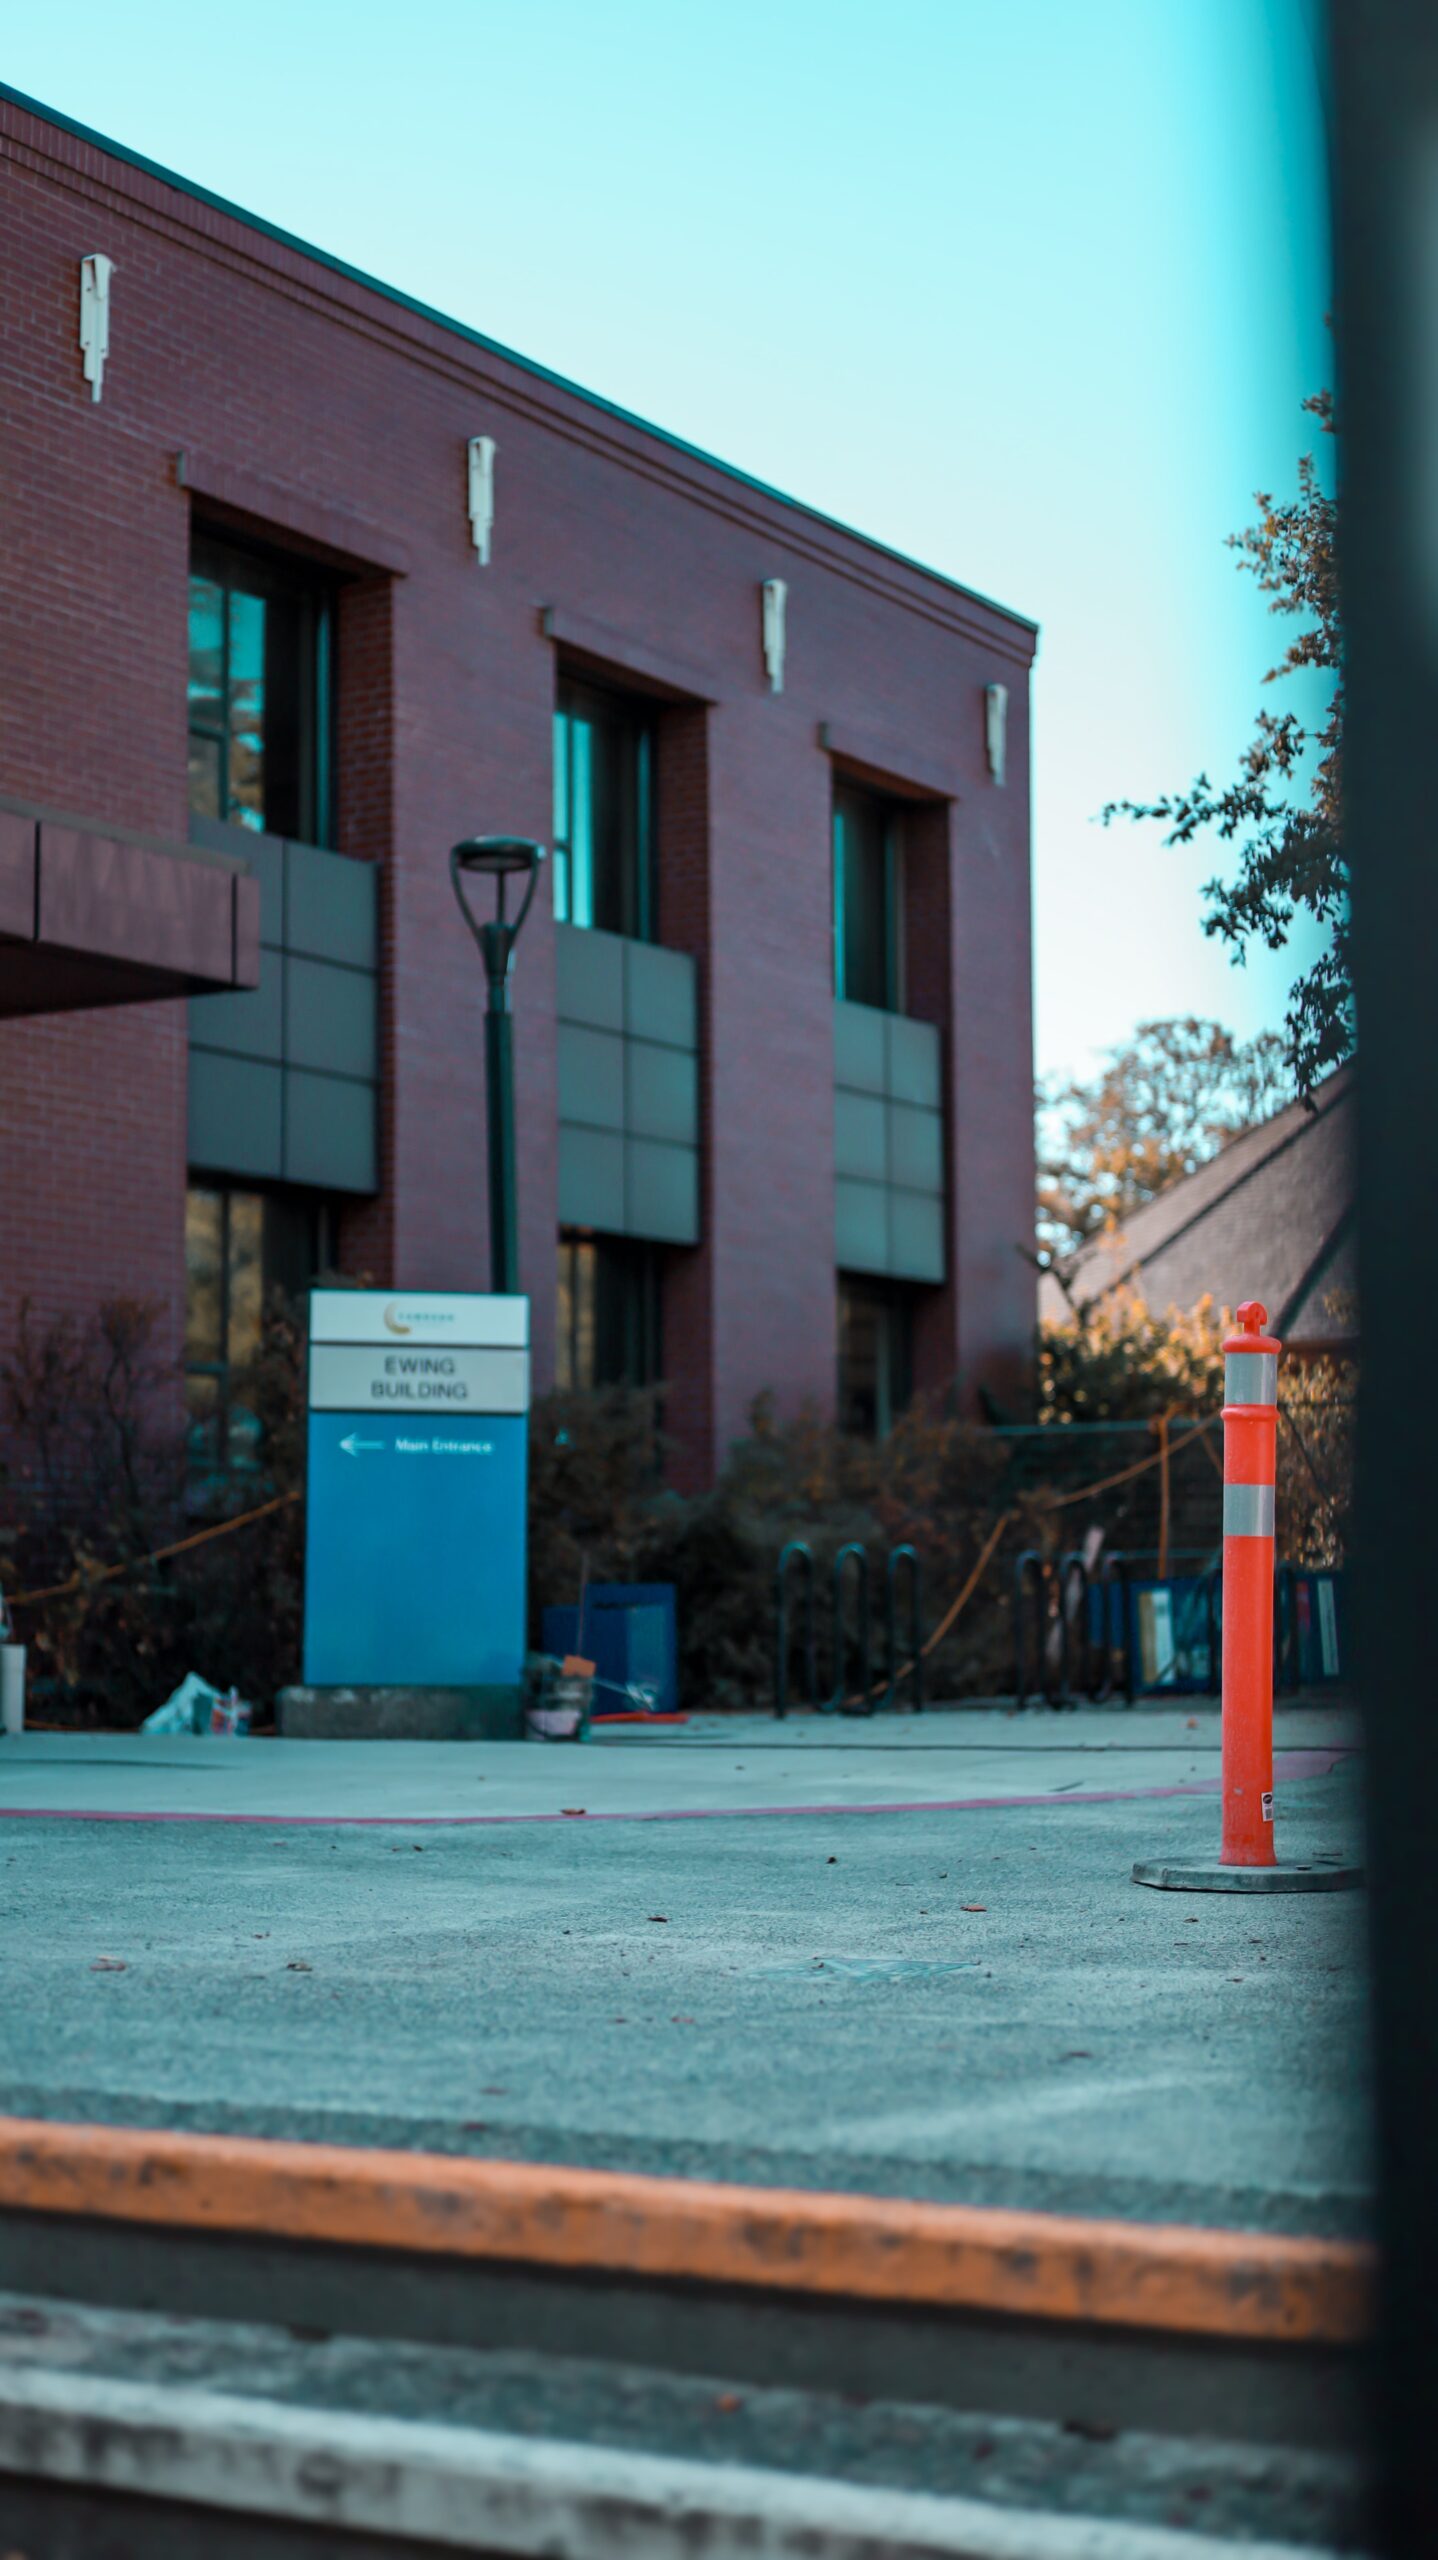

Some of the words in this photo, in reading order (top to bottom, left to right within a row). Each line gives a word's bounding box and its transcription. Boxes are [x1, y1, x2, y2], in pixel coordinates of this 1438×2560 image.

[385, 1357, 454, 1375] EWING
[371, 1381, 468, 1400] BUILDING
[395, 1437, 429, 1452] Main
[433, 1437, 492, 1454] Entrance
